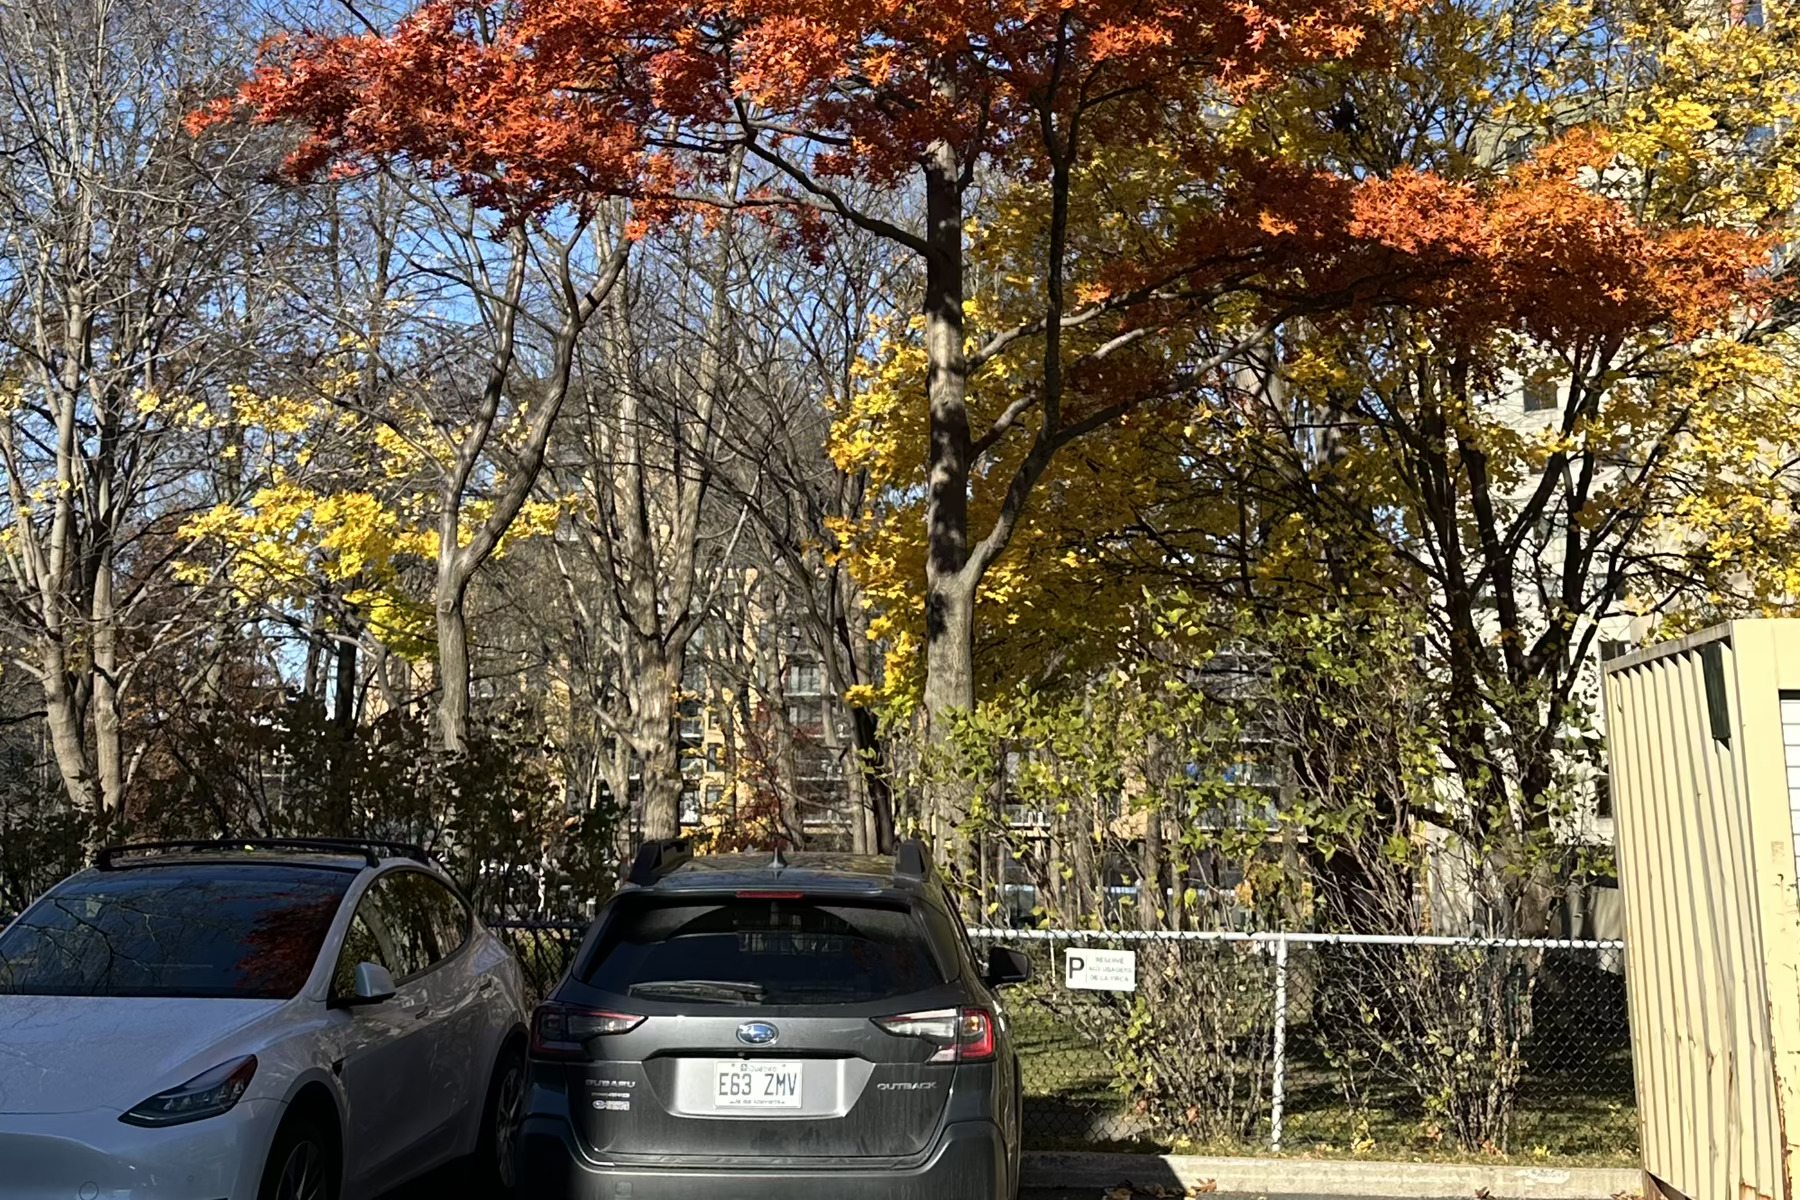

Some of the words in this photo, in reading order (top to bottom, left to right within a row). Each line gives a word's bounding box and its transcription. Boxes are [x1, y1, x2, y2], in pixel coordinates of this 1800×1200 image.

[1069, 956, 1085, 979] P
[585, 1079, 636, 1088] SUBARU
[719, 1072, 752, 1096] E63
[763, 1072, 797, 1096] ZMV
[877, 1081, 937, 1090] OUTBACK
